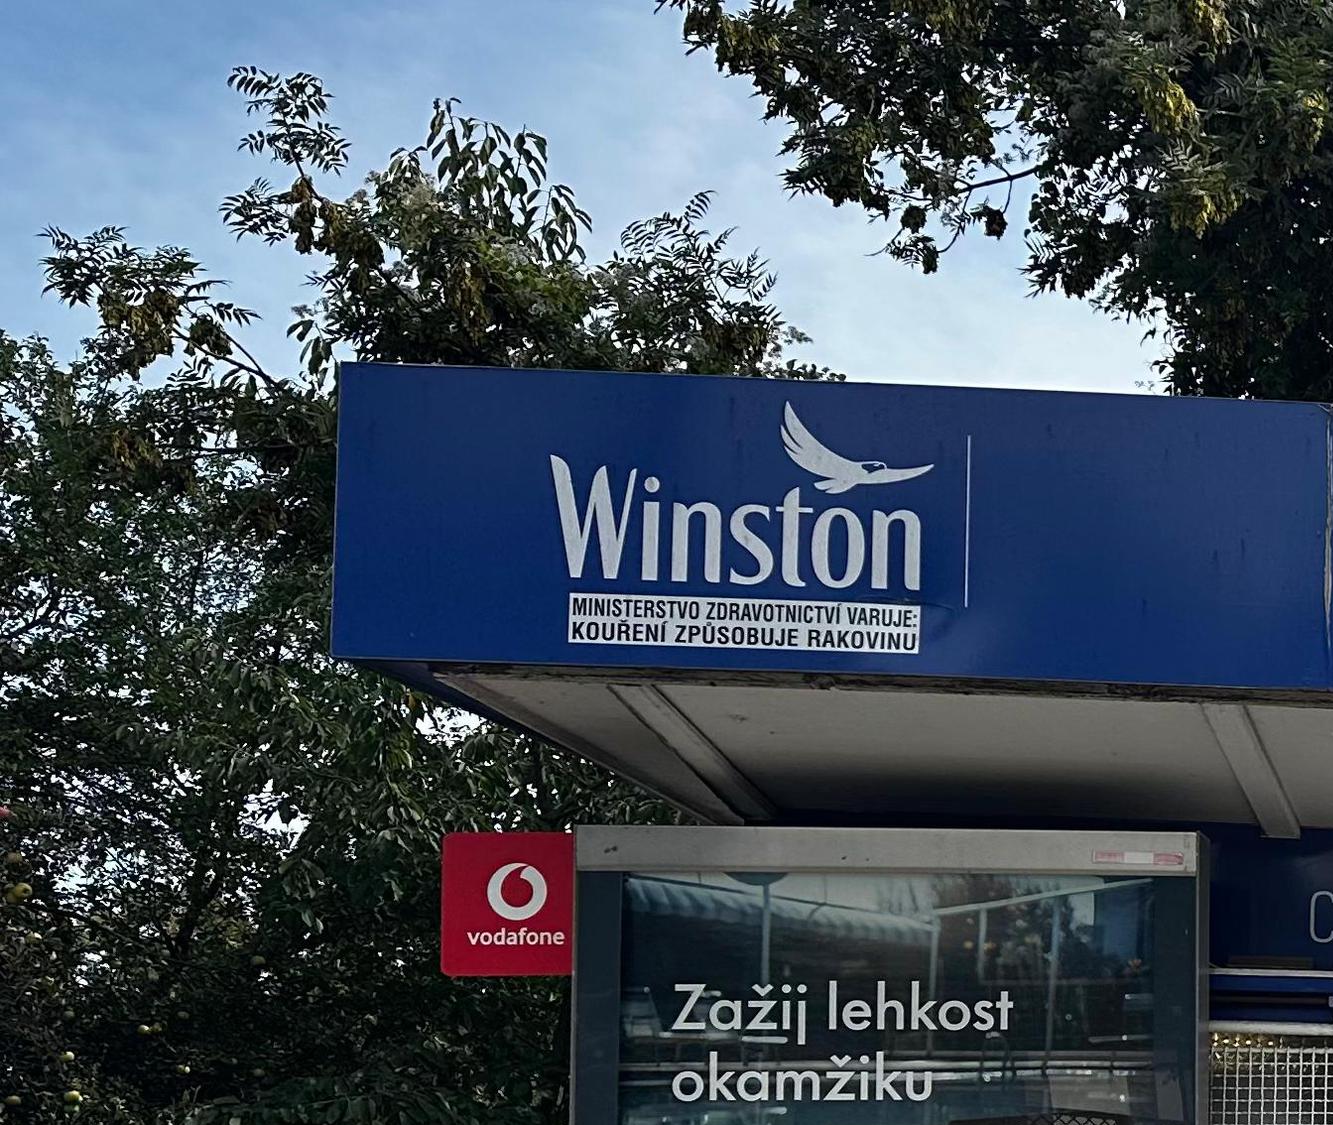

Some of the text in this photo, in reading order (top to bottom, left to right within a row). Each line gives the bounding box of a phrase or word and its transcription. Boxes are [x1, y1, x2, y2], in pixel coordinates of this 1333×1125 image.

[550, 454, 920, 591] Winston
[572, 597, 917, 628] MINISTERSTVO ZDRAVOTNICTVÍ VARUJE:
[572, 619, 916, 650] KOUŘENÍ ZPŮSOBUJE RAKOVINU
[467, 927, 565, 946] vodafone
[672, 980, 1013, 1046] Zažij lehkost
[672, 1051, 934, 1104] okamžiku
